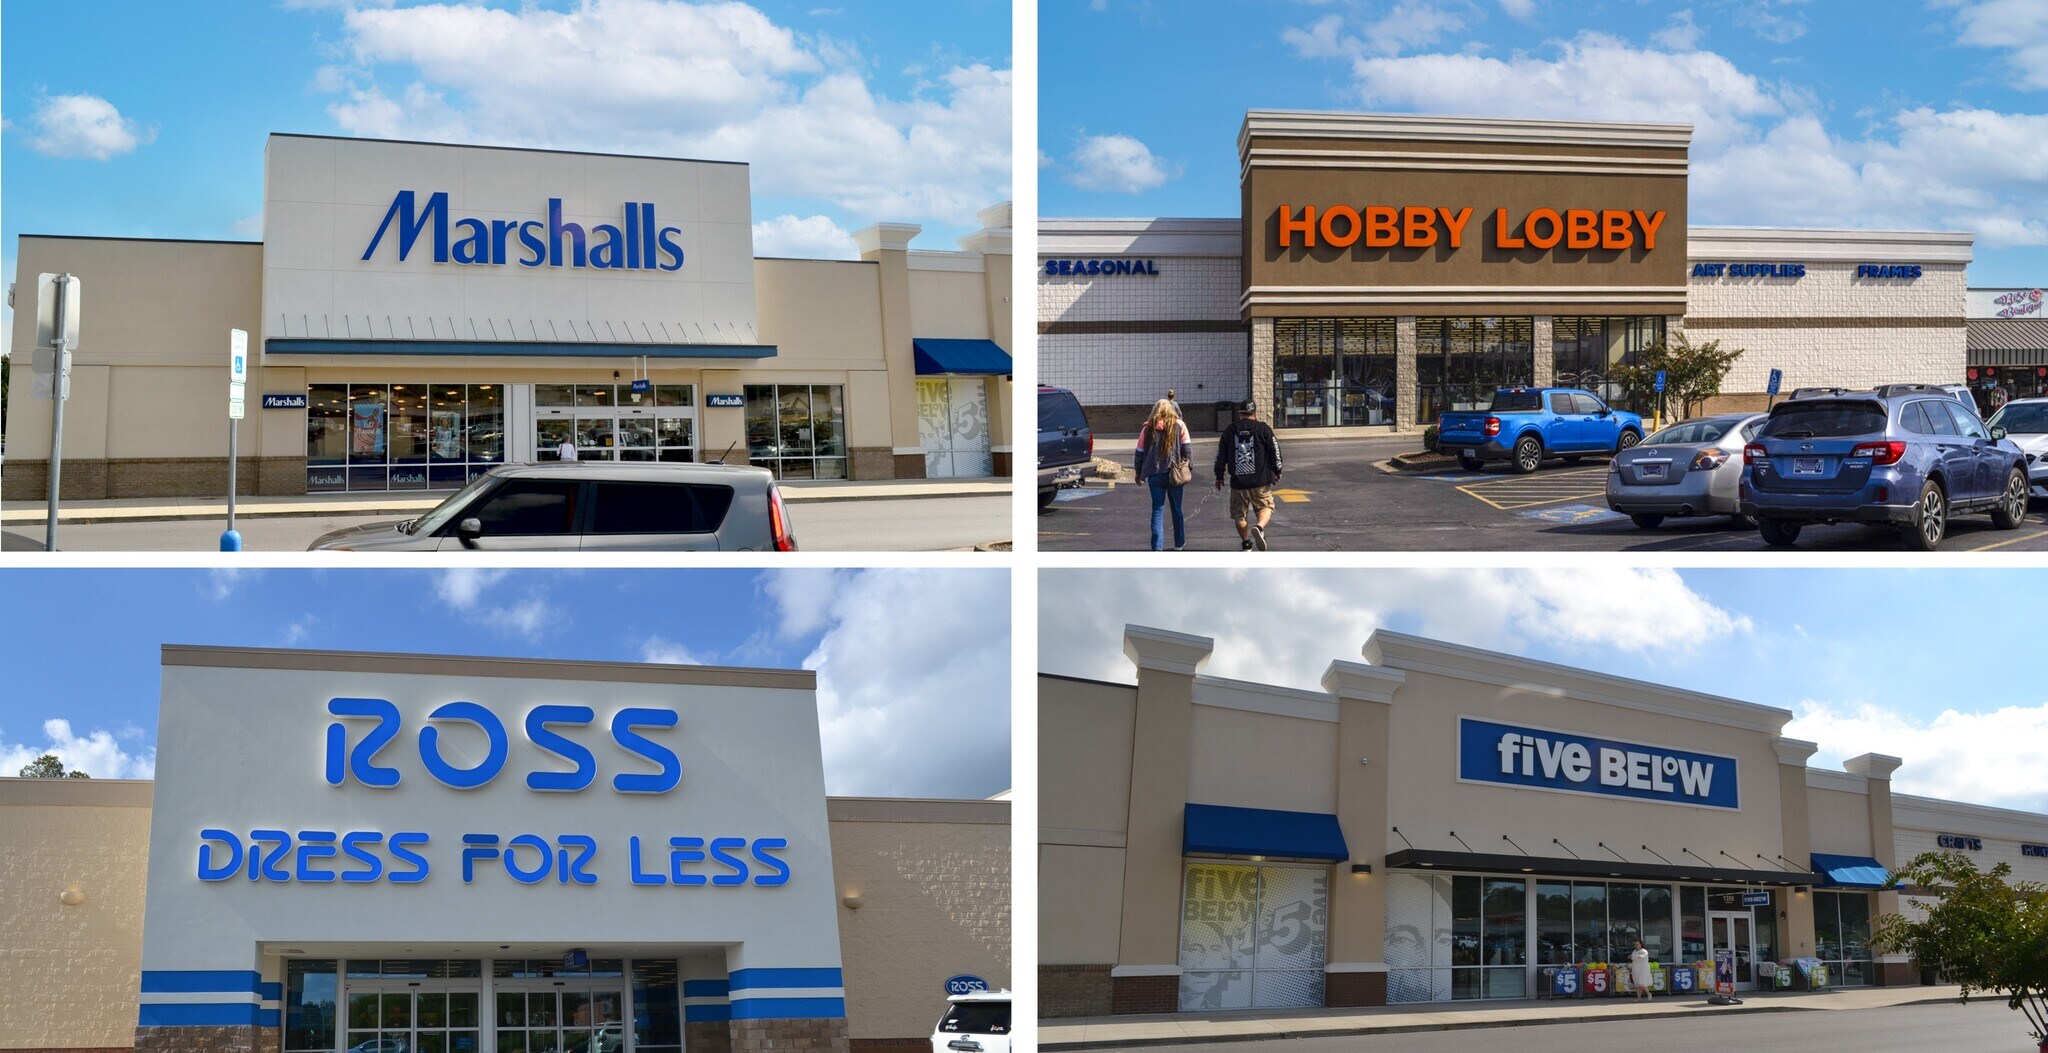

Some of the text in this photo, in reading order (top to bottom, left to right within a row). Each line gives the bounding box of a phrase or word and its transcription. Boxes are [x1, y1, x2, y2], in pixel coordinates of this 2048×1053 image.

[361, 189, 685, 272] Marshalls
[1279, 204, 1667, 250] HOBBY LOBBY
[1045, 260, 1159, 276] SEASONAL
[1692, 263, 1806, 279] ART SUPPLIES
[1857, 264, 1922, 279] FRAMES
[265, 397, 305, 407] Marshalls
[711, 396, 743, 405] Marshalls
[308, 476, 345, 484] Marshalls
[391, 473, 425, 482] Marshalls
[325, 697, 682, 793] ROSS
[1498, 733, 1714, 797] five BELOW
[1938, 835, 1982, 851] CRAFTS
[198, 829, 791, 886] DRESS FOR LESS
[1557, 973, 1577, 993] $5
[1587, 973, 1607, 992] $5
[1674, 972, 1692, 990] $5
[1777, 970, 1791, 987] $5
[1812, 969, 1827, 986] $5
[950, 981, 984, 992] ROSS
